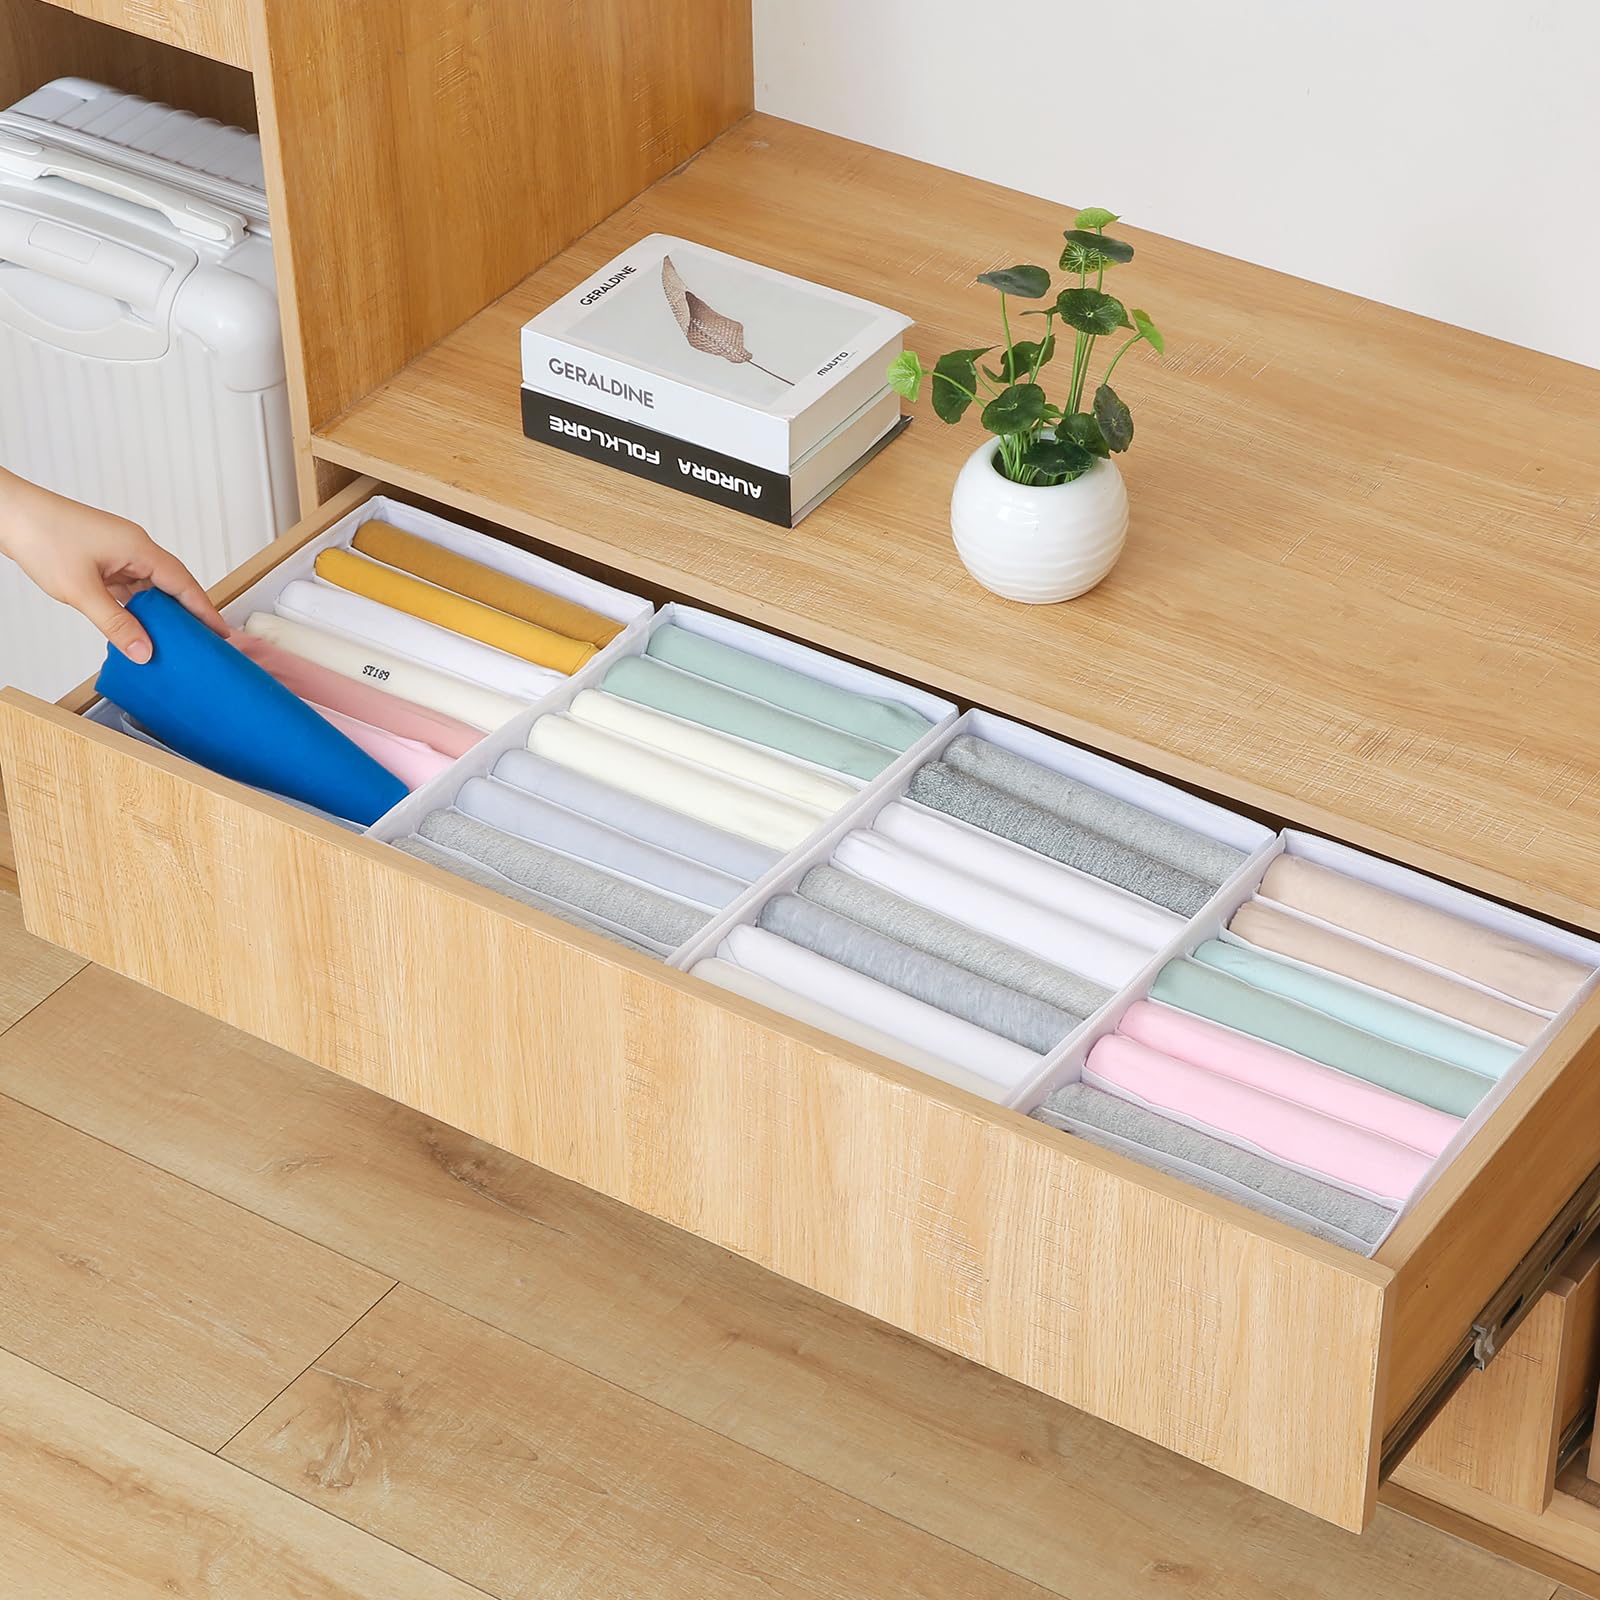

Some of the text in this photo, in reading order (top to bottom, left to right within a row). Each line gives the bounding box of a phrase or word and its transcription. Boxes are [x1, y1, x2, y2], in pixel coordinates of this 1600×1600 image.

[579, 264, 637, 306] GERALDINE
[548, 357, 655, 410] GERALDINE
[548, 415, 763, 499] AURORA FOLKLORE
